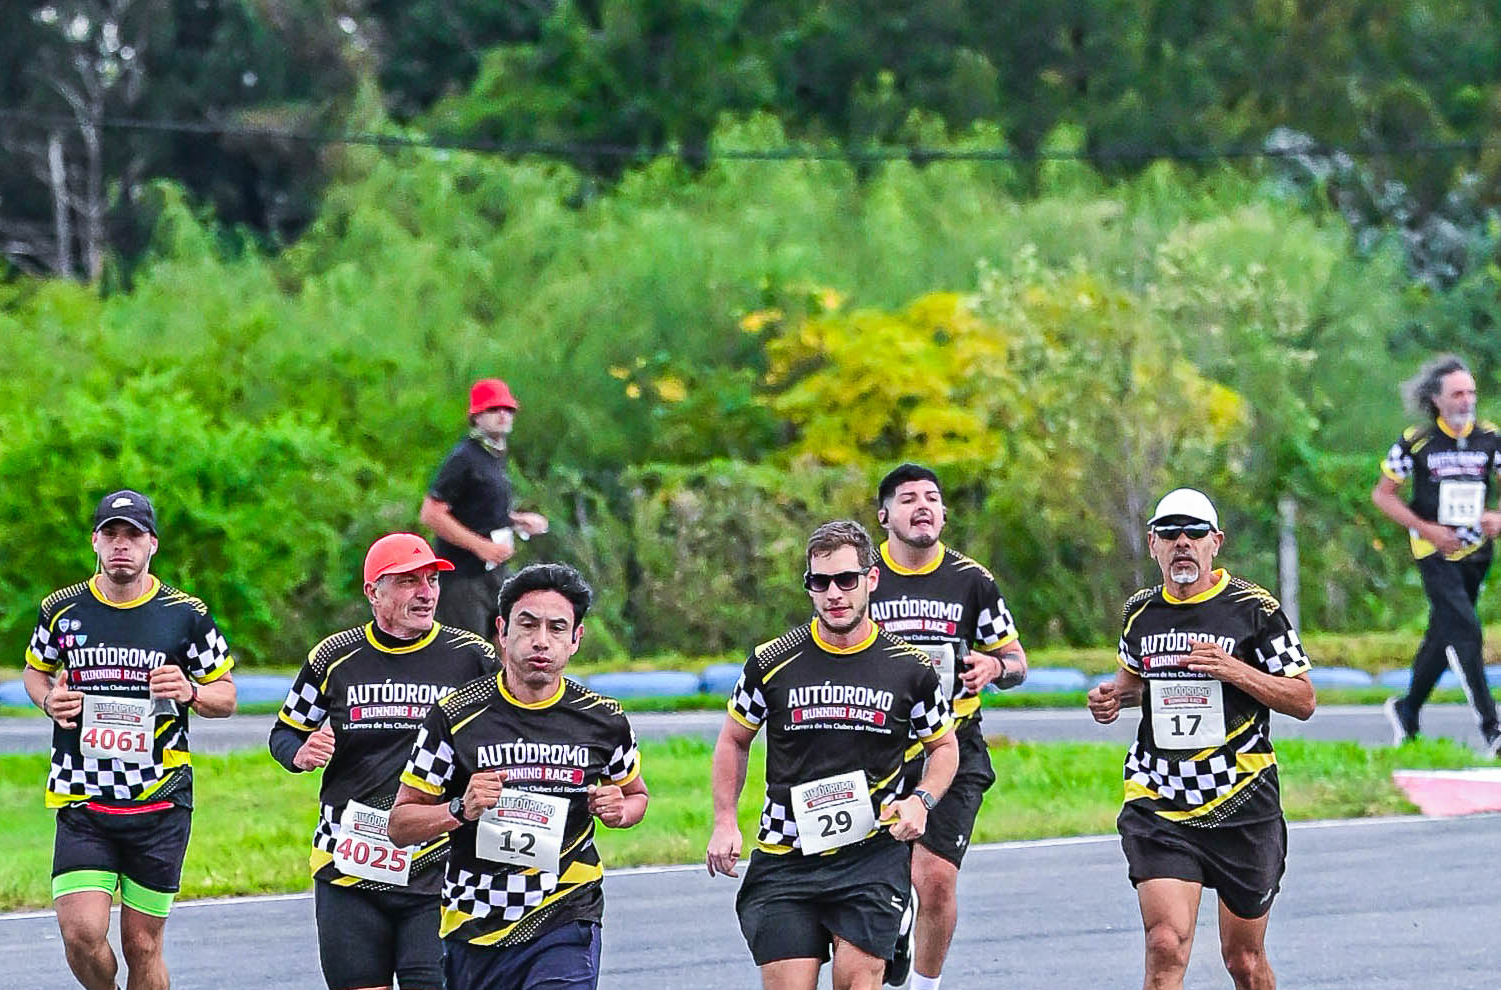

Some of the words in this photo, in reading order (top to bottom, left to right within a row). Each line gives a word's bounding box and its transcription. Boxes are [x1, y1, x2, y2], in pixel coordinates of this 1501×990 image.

[871, 595, 963, 622] AUTÓDROMO
[925, 619, 948, 633] RACE
[67, 643, 166, 669] AUTÓDROMO
[80, 669, 121, 682] RUNNING
[124, 669, 148, 682] RACE
[787, 681, 894, 712] AUTÓDROMO
[361, 706, 408, 719] RUNNING
[802, 706, 847, 720] RUNNING
[849, 707, 876, 723] RACE
[1171, 715, 1201, 736] 17
[83, 728, 148, 752] 4061
[478, 738, 589, 768] AUTÓDROMO
[499, 767, 542, 781] UNNING
[545, 768, 574, 783] RACE
[818, 810, 852, 838] 29
[337, 838, 408, 872] 4025
[499, 830, 536, 857] 12
